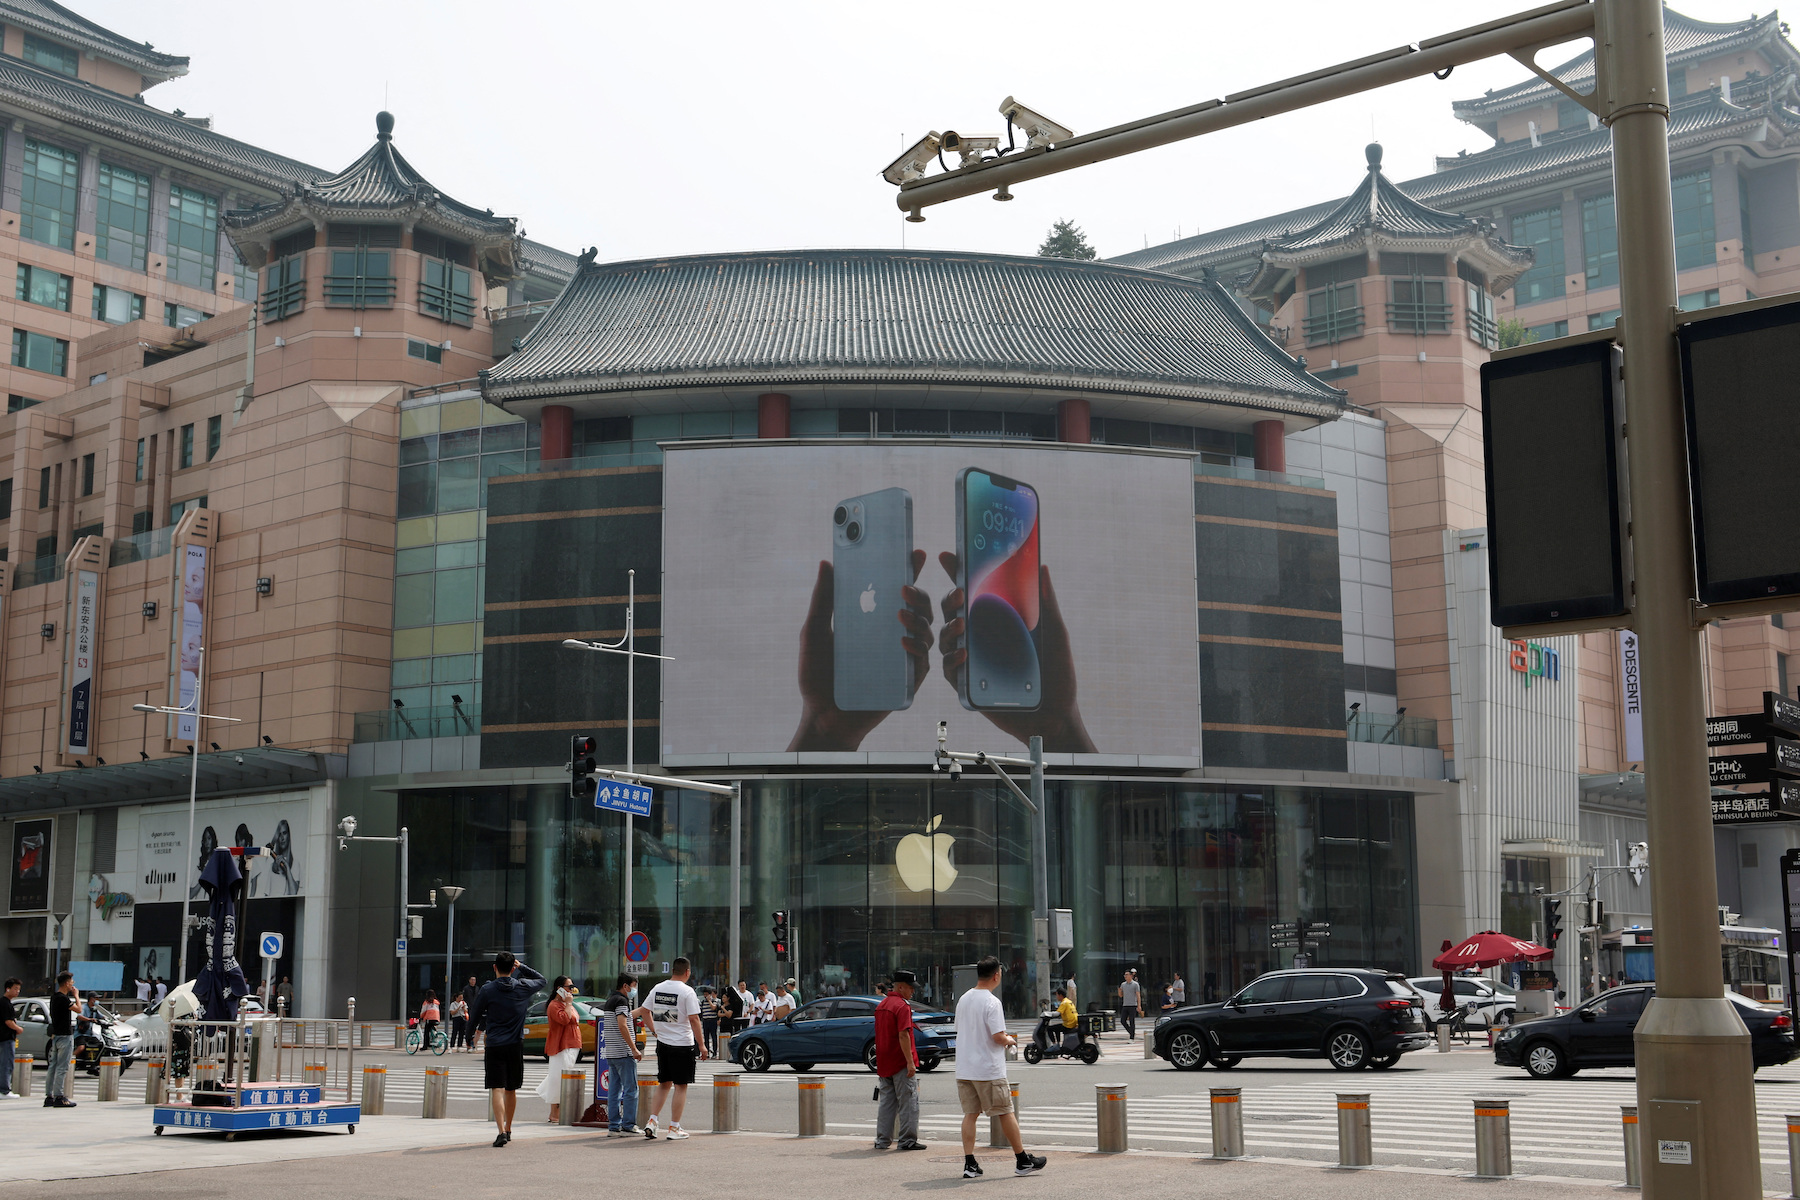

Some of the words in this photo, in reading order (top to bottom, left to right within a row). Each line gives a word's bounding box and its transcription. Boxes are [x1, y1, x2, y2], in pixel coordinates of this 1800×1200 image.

[983, 509, 1025, 538] 09:41
[1460, 542, 1480, 551] apm
[79, 596, 91, 653] 新东安办公楼
[1510, 640, 1560, 688] apm
[1624, 649, 1640, 714] DESCENTE
[1721, 733, 1751, 741] HUTONG
[612, 786, 650, 803] 金鱼胡同
[611, 799, 628, 808] JINYU
[629, 803, 648, 813] Hutong
[95, 893, 129, 920] apm
[627, 963, 648, 973] 金鱼胡同
[250, 1089, 309, 1104] 值勤岗台
[174, 1111, 211, 1128] 值勤岗台
[269, 1110, 328, 1126] 值勤岗台
